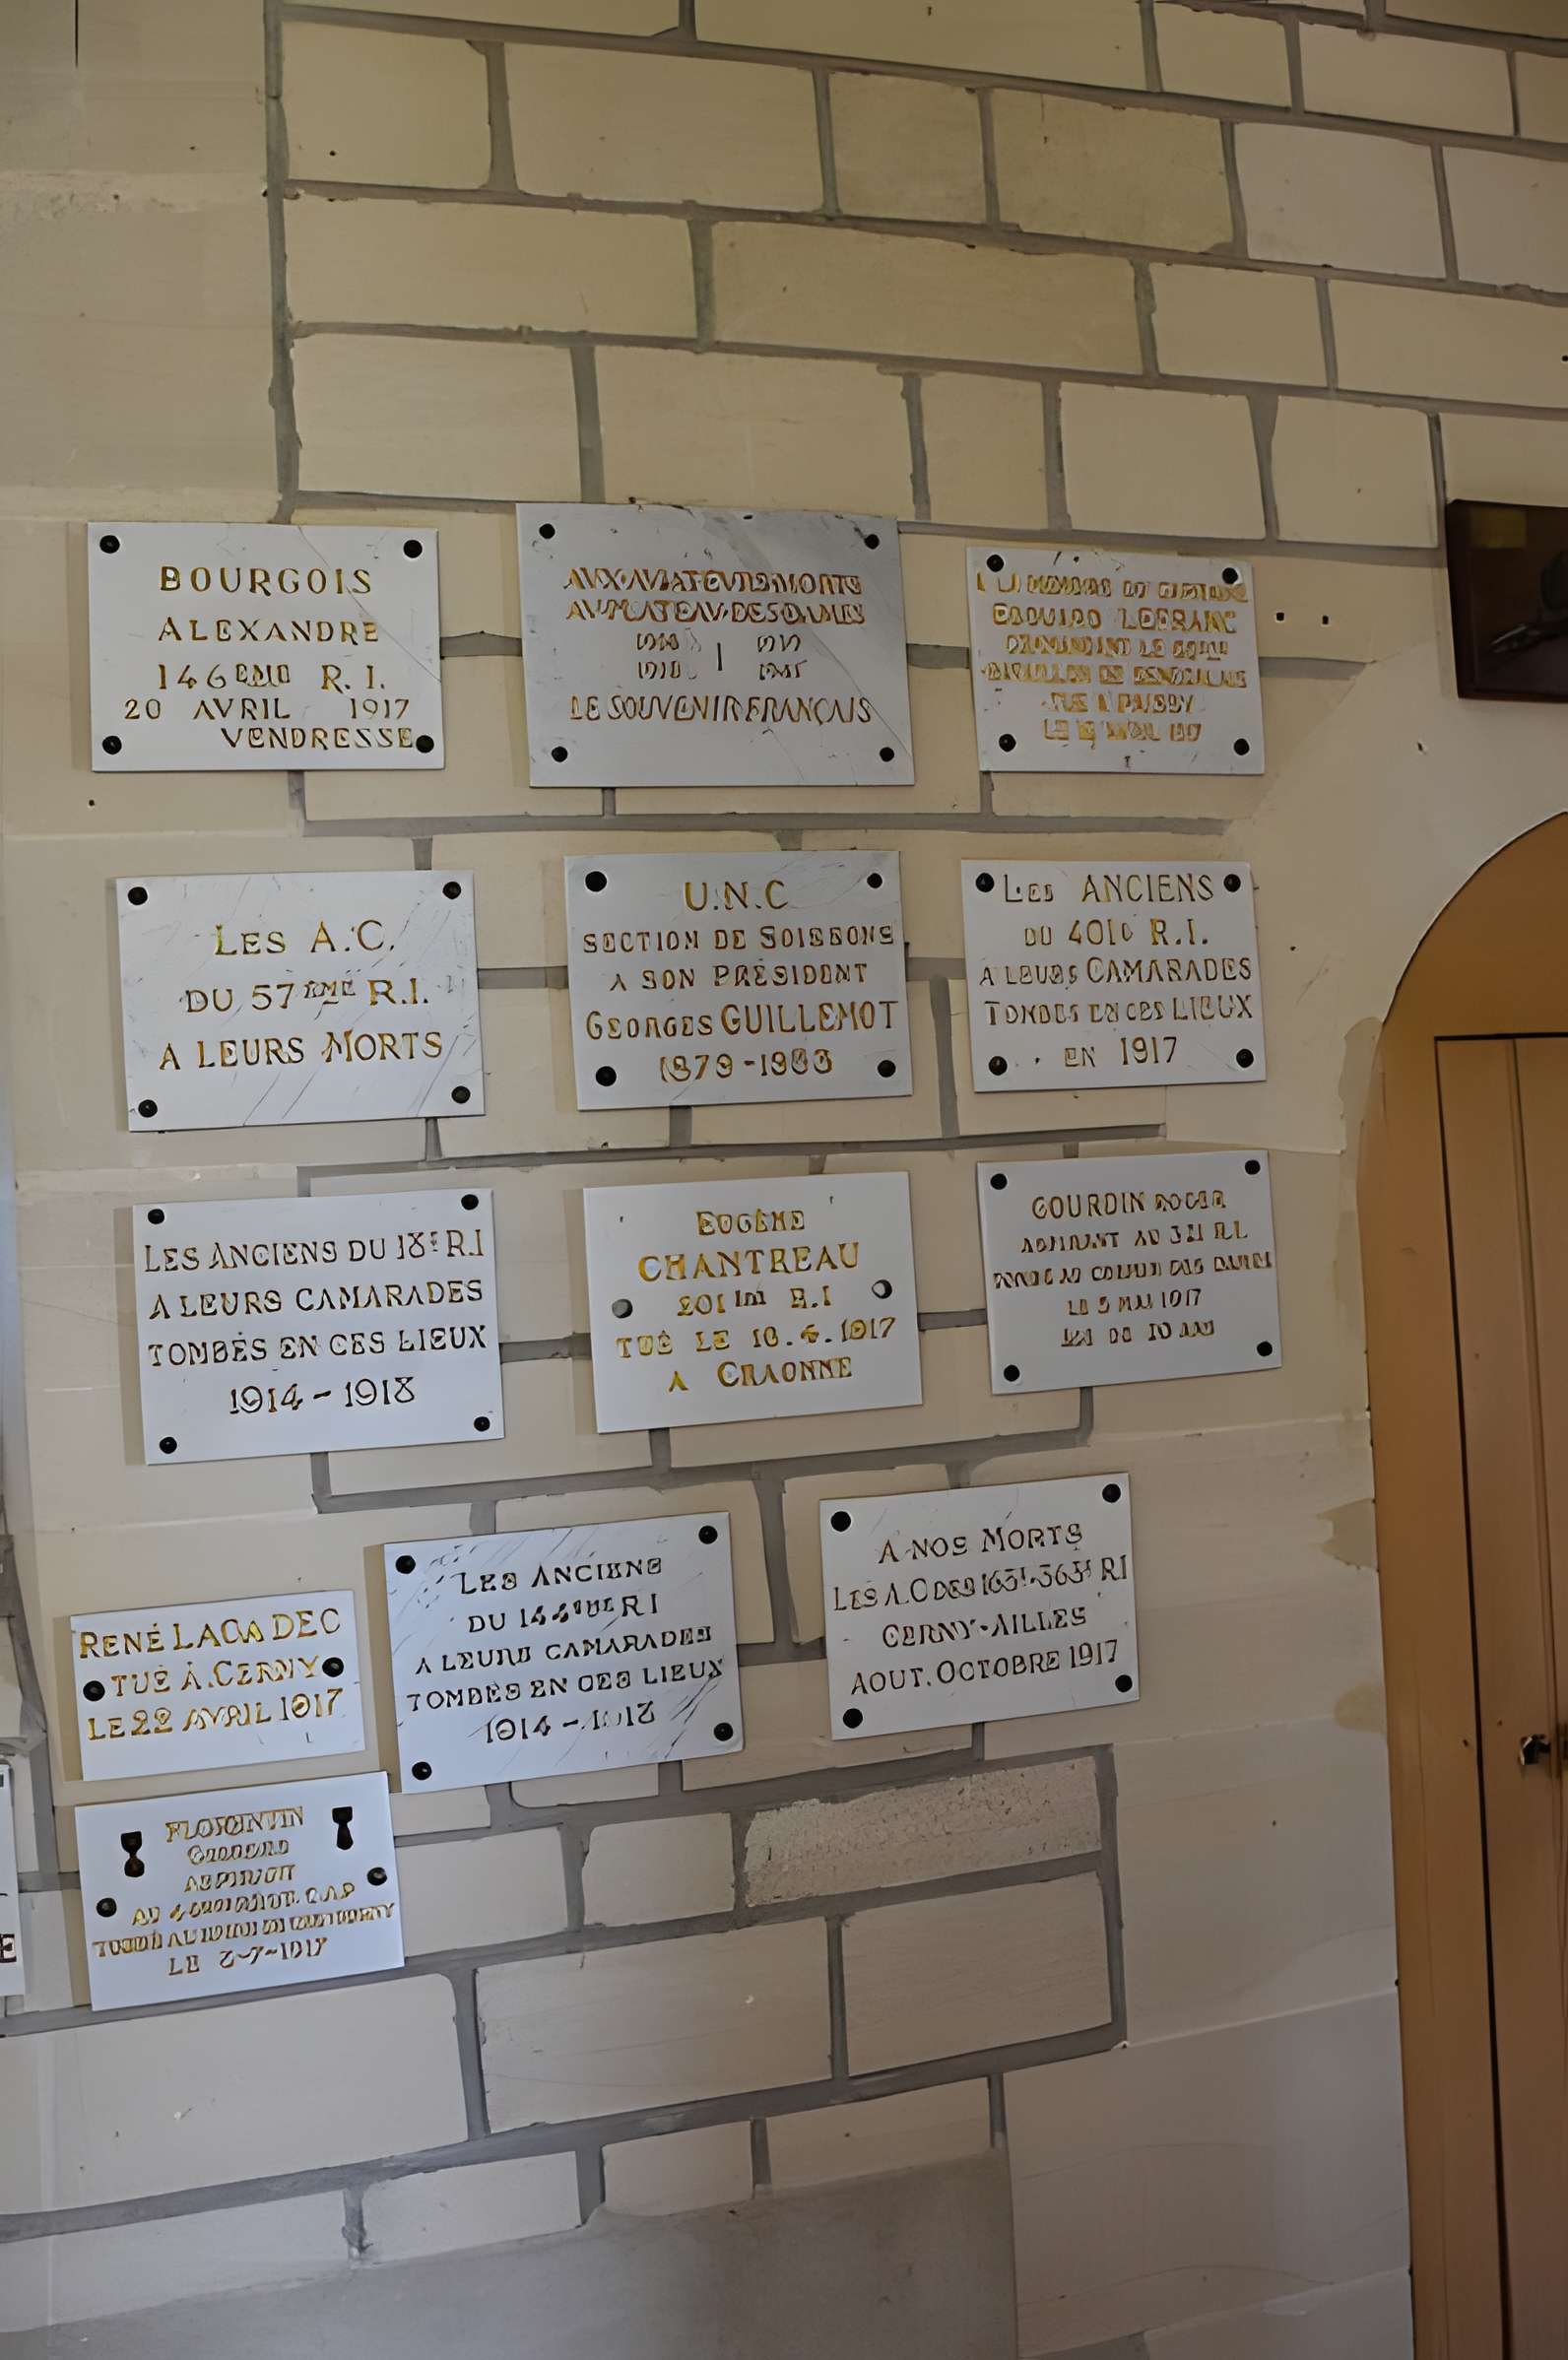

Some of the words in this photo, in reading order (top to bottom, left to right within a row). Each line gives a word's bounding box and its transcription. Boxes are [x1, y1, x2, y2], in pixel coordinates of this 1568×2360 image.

[160, 566, 371, 596] BOURGOIS
[158, 617, 379, 645] ALEXANDRE
[124, 698, 162, 720] 20
[193, 697, 292, 720] AVRIL
[351, 698, 410, 720] 1917
[570, 695, 599, 720] LE
[221, 727, 414, 751] VENDRESSE
[1005, 874, 1054, 902] LES
[1081, 873, 1214, 902] ANCIENS
[215, 924, 287, 955] LES
[583, 931, 699, 952] SECTION
[715, 930, 747, 950] DE
[642, 969, 695, 989] SON
[980, 967, 995, 986] A
[1086, 957, 1252, 983] CAMARADES
[185, 989, 233, 1013] DU
[1173, 995, 1253, 1019] LIEUX
[586, 1011, 713, 1040] GEORGES
[721, 1001, 898, 1035] GUILLEMOT
[159, 1043, 181, 1071] A
[197, 1037, 304, 1069] LEURS
[321, 1030, 442, 1063] MORTS
[1064, 1047, 1095, 1067] EN
[1120, 1036, 1177, 1066] 1917
[1032, 1191, 1145, 1219] GOURDIN
[144, 1245, 200, 1273] LES
[209, 1241, 338, 1270] ANCIENS
[349, 1238, 386, 1262] DU
[638, 1242, 860, 1281] CHANTREAU
[149, 1294, 170, 1319] A
[181, 1291, 283, 1317] LEURS
[295, 1280, 483, 1311] CAMARADES
[280, 1336, 318, 1359] EN
[330, 1333, 385, 1355] CES
[399, 1325, 487, 1352] LIEUX
[695, 1330, 730, 1352] LE
[717, 1357, 853, 1387] CRAONNE
[879, 1540, 898, 1564] A
[912, 1536, 967, 1559] NOS
[982, 1523, 1082, 1552] MORTS
[460, 1572, 517, 1595] LES
[833, 1586, 878, 1610] LES
[469, 1613, 506, 1633] DU
[79, 1623, 164, 1659] RENÉ
[415, 1658, 432, 1675] A
[546, 1626, 711, 1660] CAMARADES
[937, 1650, 1060, 1684] OCTOBRE
[1070, 1639, 1118, 1669] 1917
[530, 1678, 567, 1698] EN
[643, 1656, 725, 1685] LIEUX
[88, 1717, 126, 1740] LE
